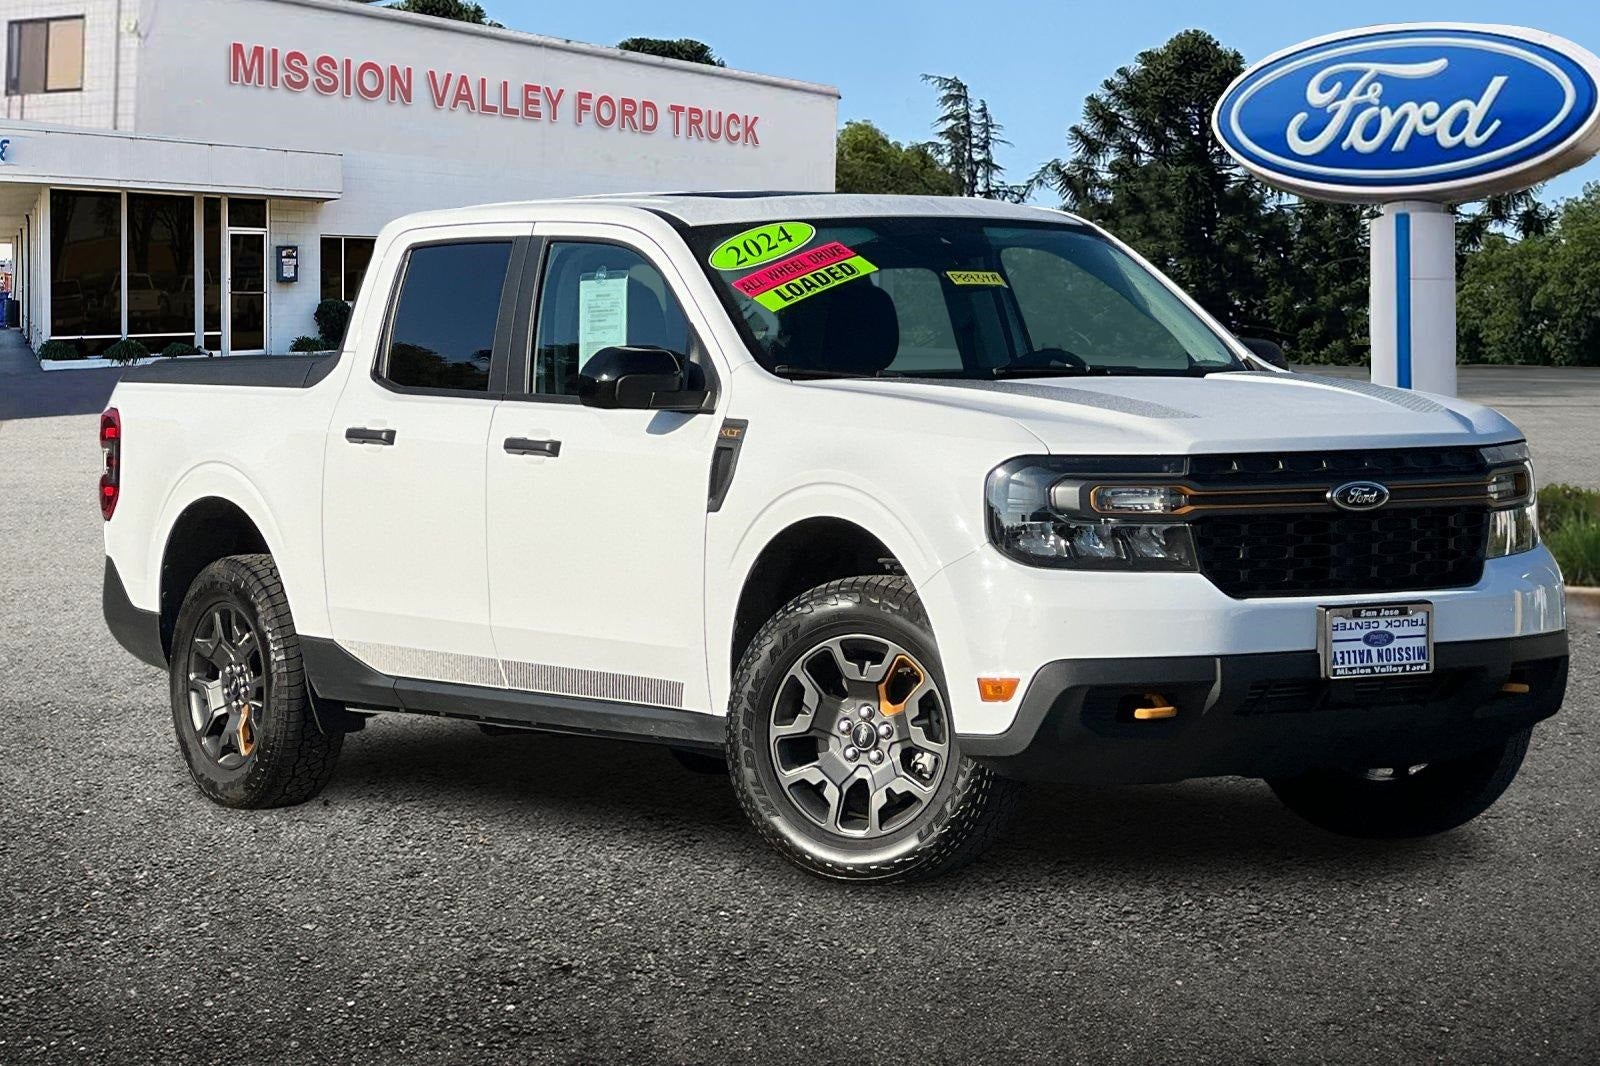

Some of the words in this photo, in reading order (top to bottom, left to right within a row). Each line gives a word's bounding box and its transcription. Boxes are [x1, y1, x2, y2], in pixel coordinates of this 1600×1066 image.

[229, 41, 413, 105] MISSION
[427, 69, 565, 122] VALLEY
[576, 90, 659, 134] FORD
[668, 104, 760, 146] TRUCK
[1286, 57, 1508, 156] Ford
[726, 226, 793, 266] 2024
[742, 279, 766, 293] ALL
[766, 261, 808, 282] WHEEL
[809, 245, 845, 265] DRIVE
[773, 262, 860, 302] LOADED
[720, 428, 741, 437] XLT
[1347, 487, 1378, 504] Ford
[1360, 609, 1377, 617] San
[1380, 608, 1400, 616] Jose
[1384, 618, 1426, 629] TRUCK
[1332, 649, 1374, 666] VALLEY
[1376, 645, 1426, 663] MISSION
[1373, 664, 1404, 674] Valley
